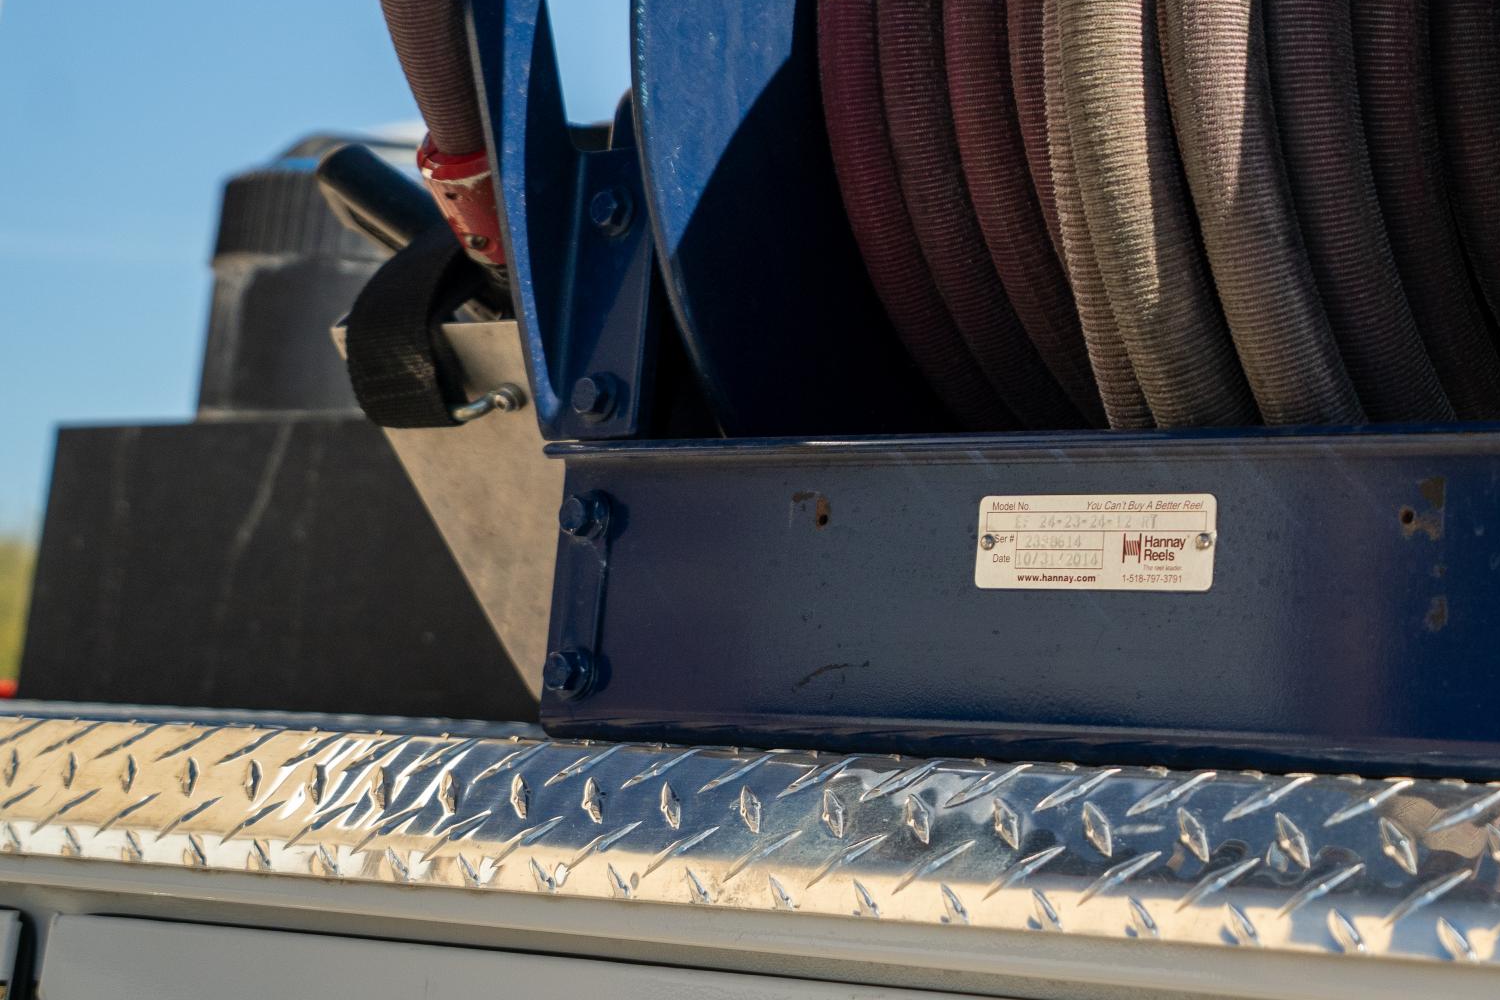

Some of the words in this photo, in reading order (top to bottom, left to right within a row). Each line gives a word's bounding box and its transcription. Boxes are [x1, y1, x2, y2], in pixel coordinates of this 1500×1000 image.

[992, 502, 1016, 511] Model
[1086, 501, 1101, 510] You
[1104, 500, 1127, 510] Can't
[1128, 500, 1144, 511] Buy
[1145, 500, 1153, 510] A
[1155, 500, 1181, 510] Better
[1183, 500, 1204, 510] Reel
[994, 534, 1008, 543] Ser
[1009, 534, 1015, 542] #
[1144, 535, 1186, 550] Hannay
[992, 553, 1011, 563] Date
[1143, 549, 1175, 561] Reels
[1017, 573, 1096, 583] www.hannay.com
[1122, 574, 1182, 583] 1-518-797-3791
